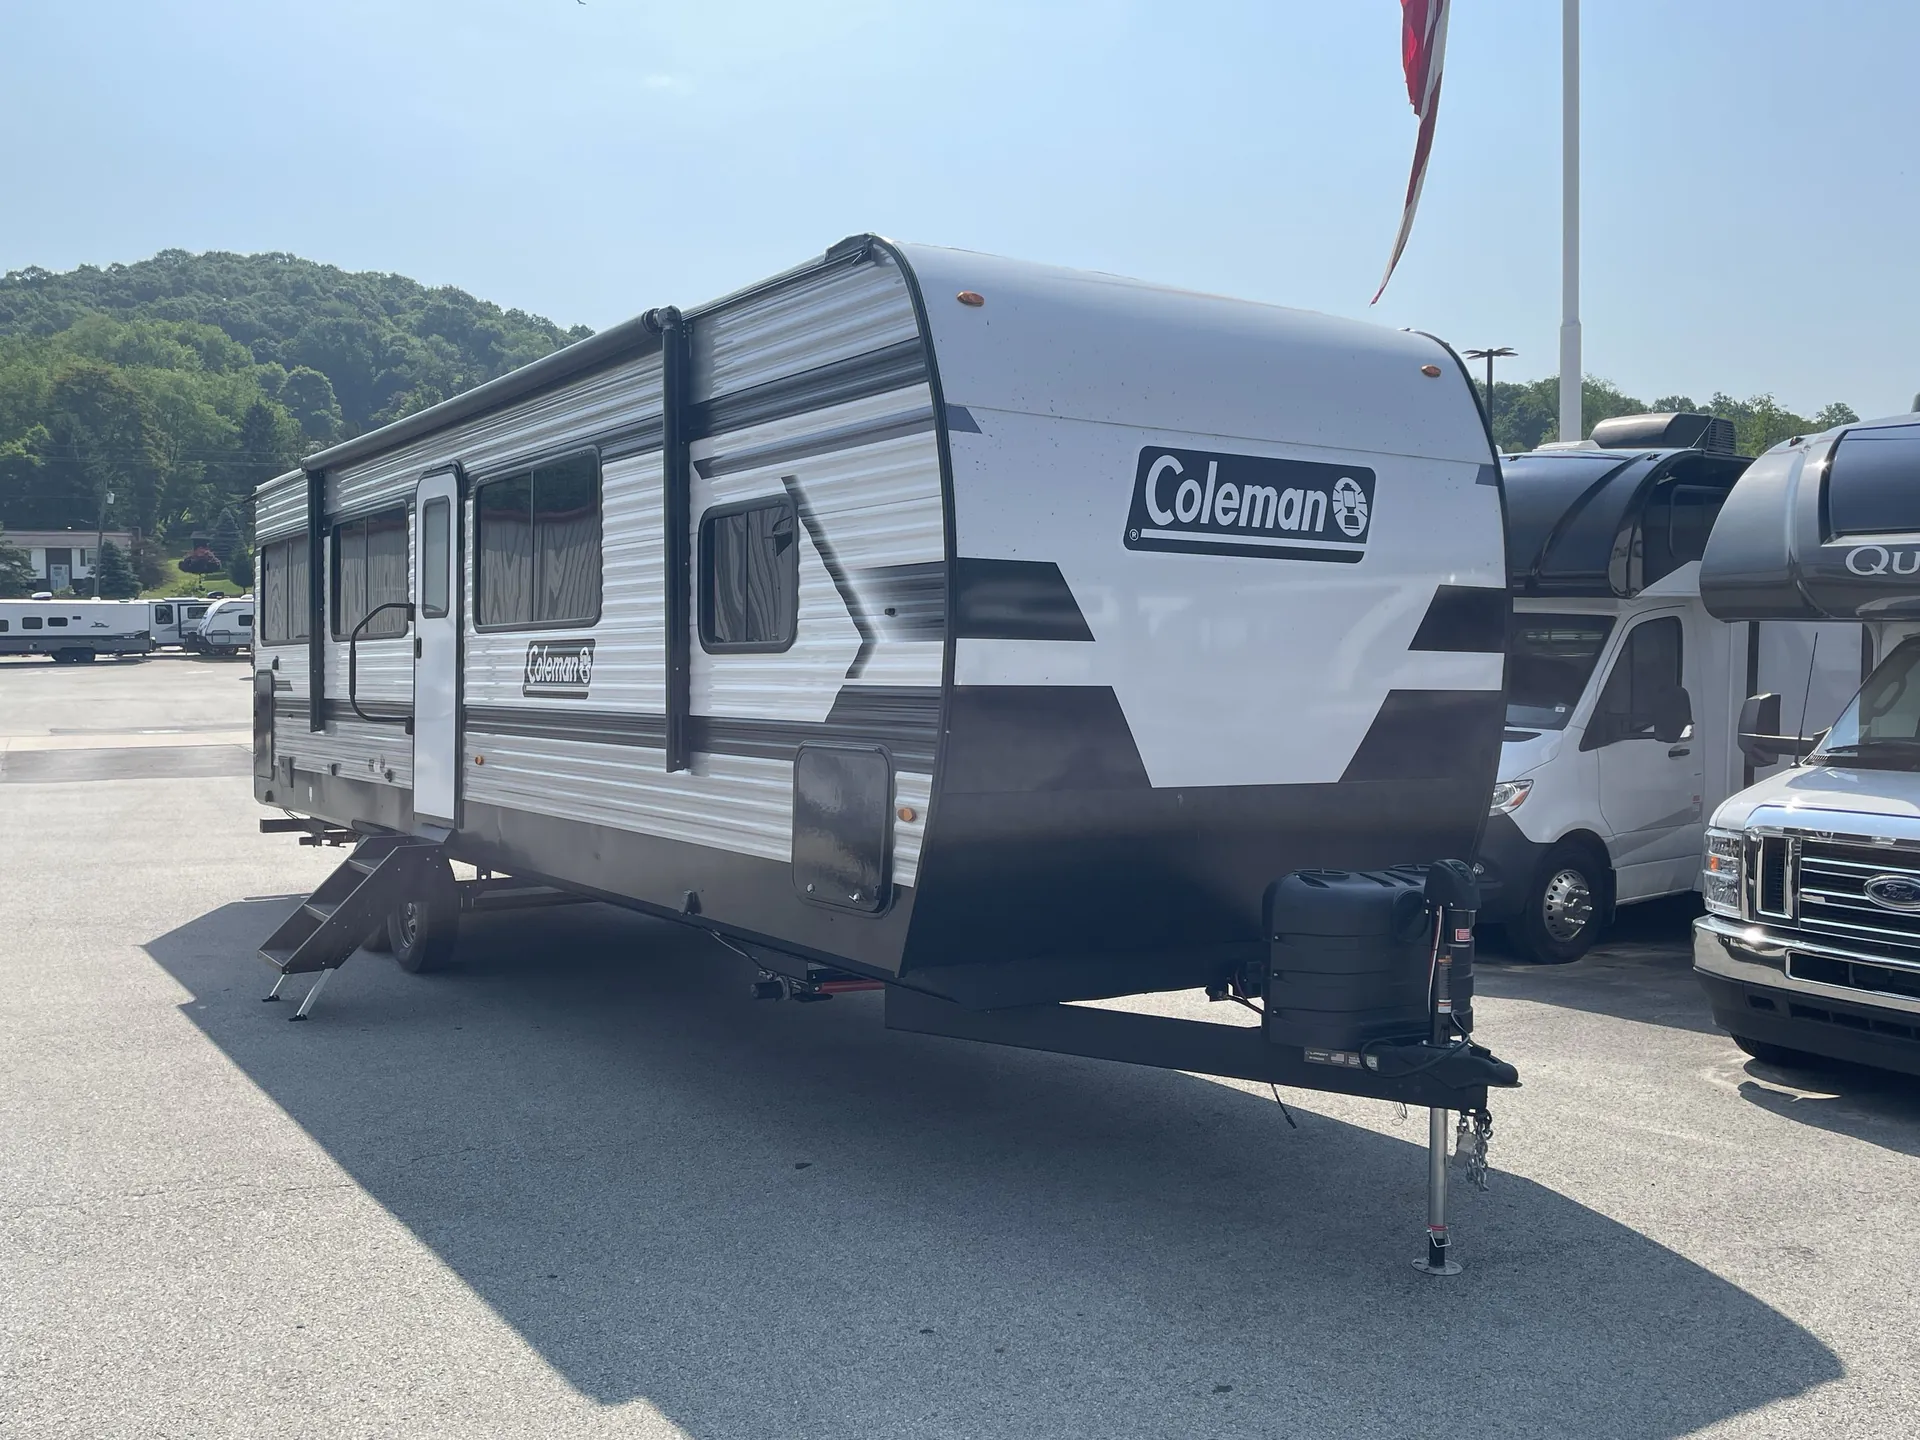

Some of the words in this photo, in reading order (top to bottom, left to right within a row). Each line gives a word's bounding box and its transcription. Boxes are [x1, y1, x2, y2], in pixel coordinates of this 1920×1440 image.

[1145, 454, 1328, 533] Coleman
[527, 644, 579, 684] Coleman
[1882, 883, 1917, 900] Ford
